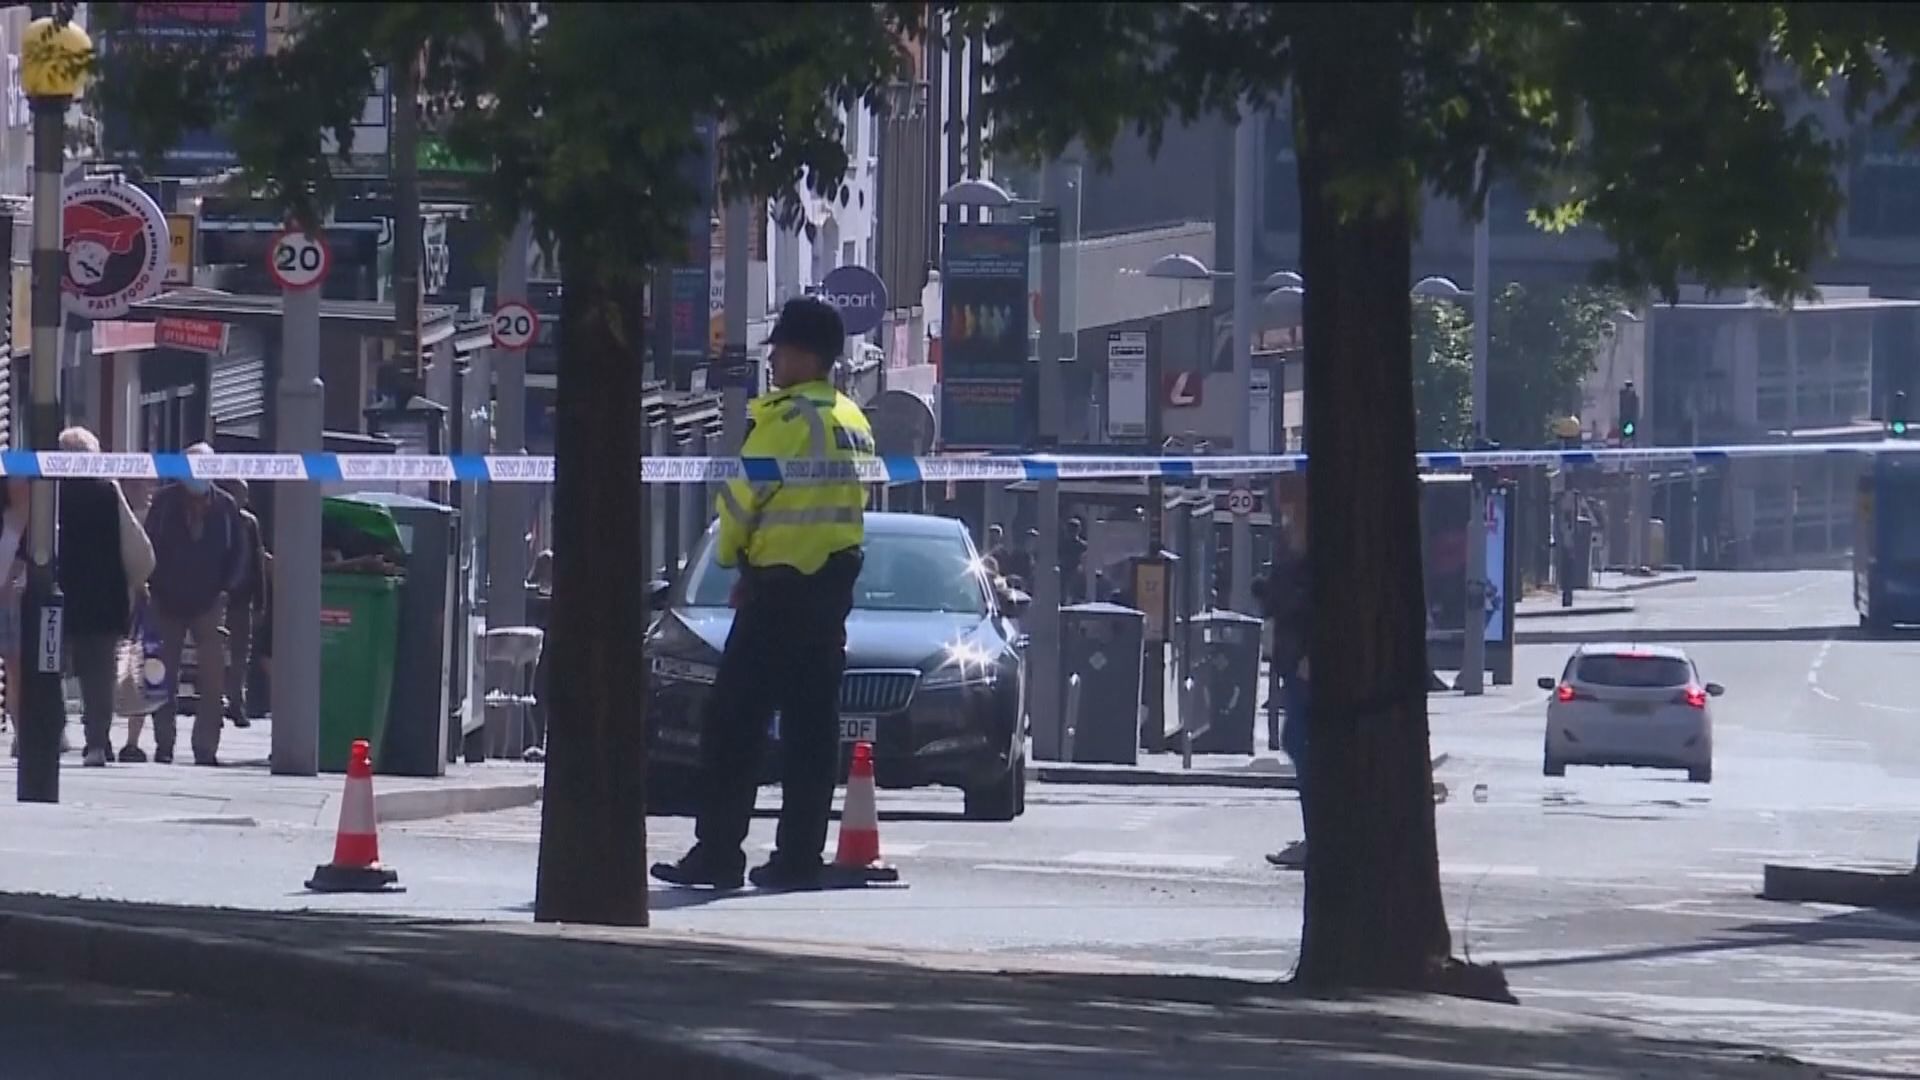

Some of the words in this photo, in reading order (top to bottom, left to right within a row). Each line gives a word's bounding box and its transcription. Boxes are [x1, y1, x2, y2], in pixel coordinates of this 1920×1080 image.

[277, 245, 320, 271] 20
[121, 274, 150, 302] FOOD
[496, 316, 530, 335] 20
[45, 457, 72, 474] CROSS
[72, 457, 90, 474] NOT
[90, 457, 102, 474] DO
[103, 457, 122, 474] LINE
[122, 457, 149, 474] POLICE
[196, 458, 223, 475] CROSS
[241, 458, 254, 475] DO
[254, 458, 272, 475] LINE
[272, 458, 299, 475] POLICE
[389, 459, 402, 476] DO
[420, 459, 449, 476] POLICE
[494, 460, 520, 477] CROSS
[519, 460, 537, 477] NOT
[537, 460, 550, 477] DO
[667, 461, 683, 478] NOT
[683, 461, 695, 478] DO
[695, 461, 712, 478] LINE
[713, 461, 739, 478] POLICE
[855, 460, 881, 477] POLICE
[925, 460, 949, 477] CROSS
[948, 460, 965, 477] NOT
[965, 460, 976, 477] DO
[976, 460, 993, 477] LINE
[993, 460, 1018, 477] POLICE
[1231, 495, 1250, 507] 20
